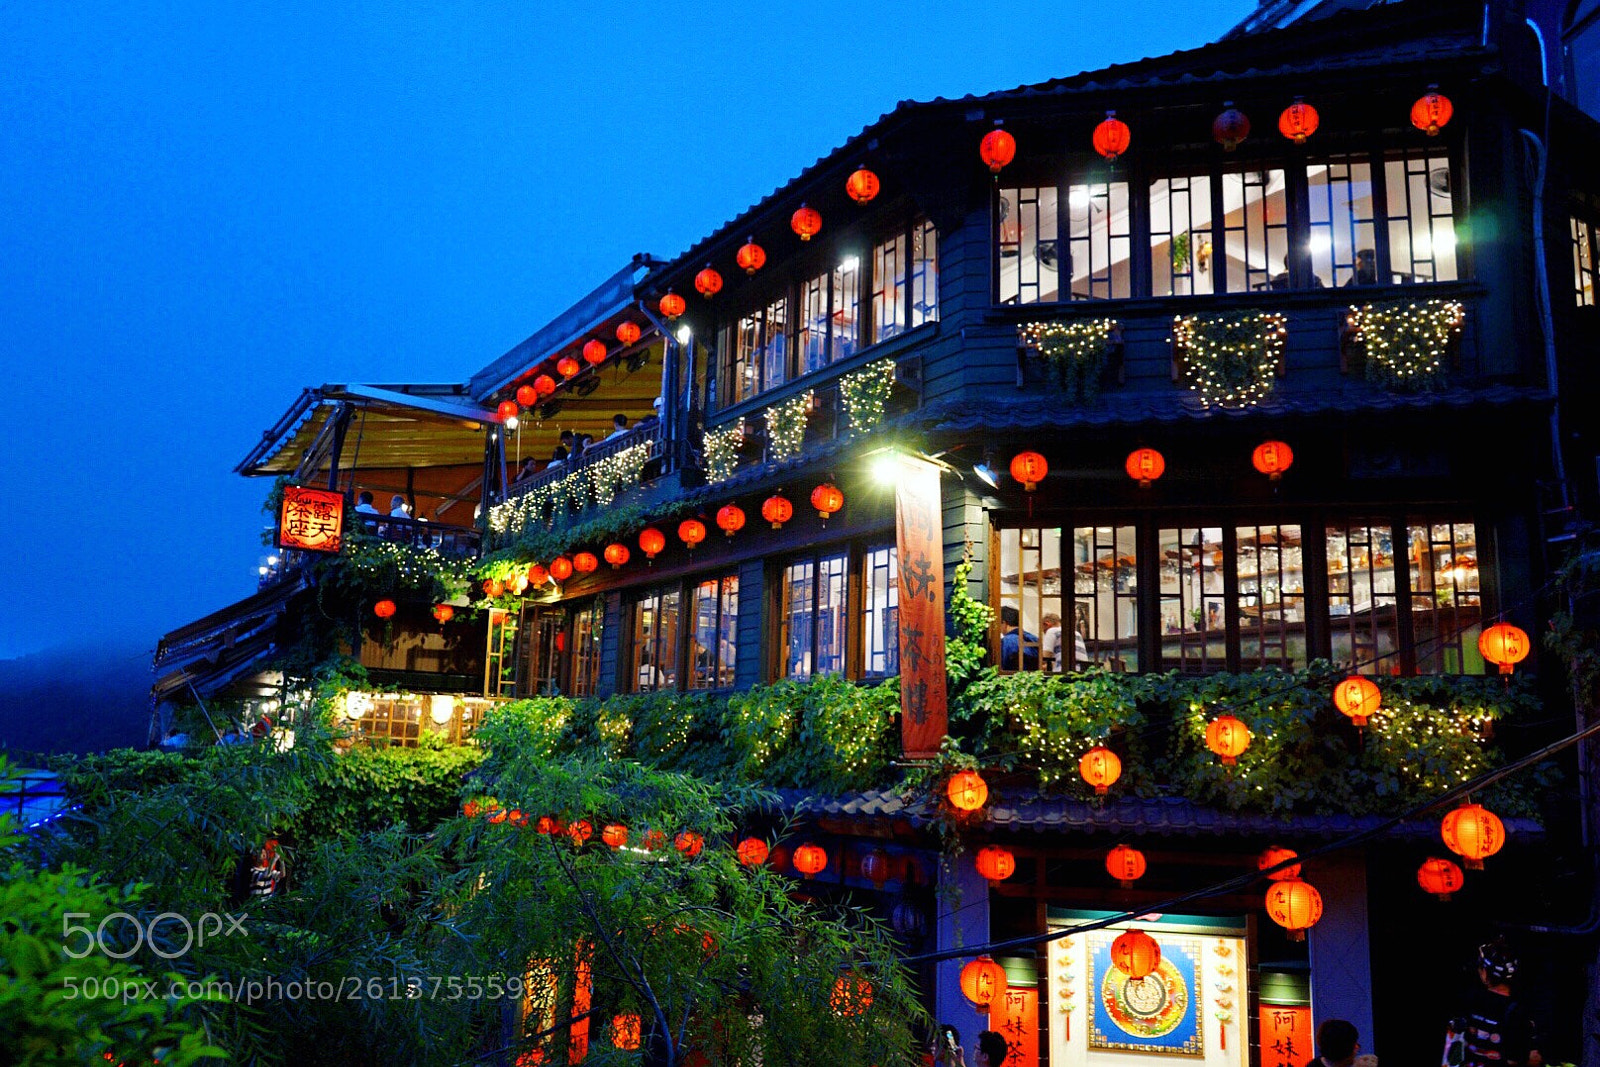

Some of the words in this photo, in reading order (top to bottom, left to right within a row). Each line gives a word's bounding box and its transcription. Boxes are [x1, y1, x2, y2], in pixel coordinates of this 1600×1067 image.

[1001, 991, 1028, 1067] 阿妹茶
[1271, 1011, 1299, 1067] 阿妹
